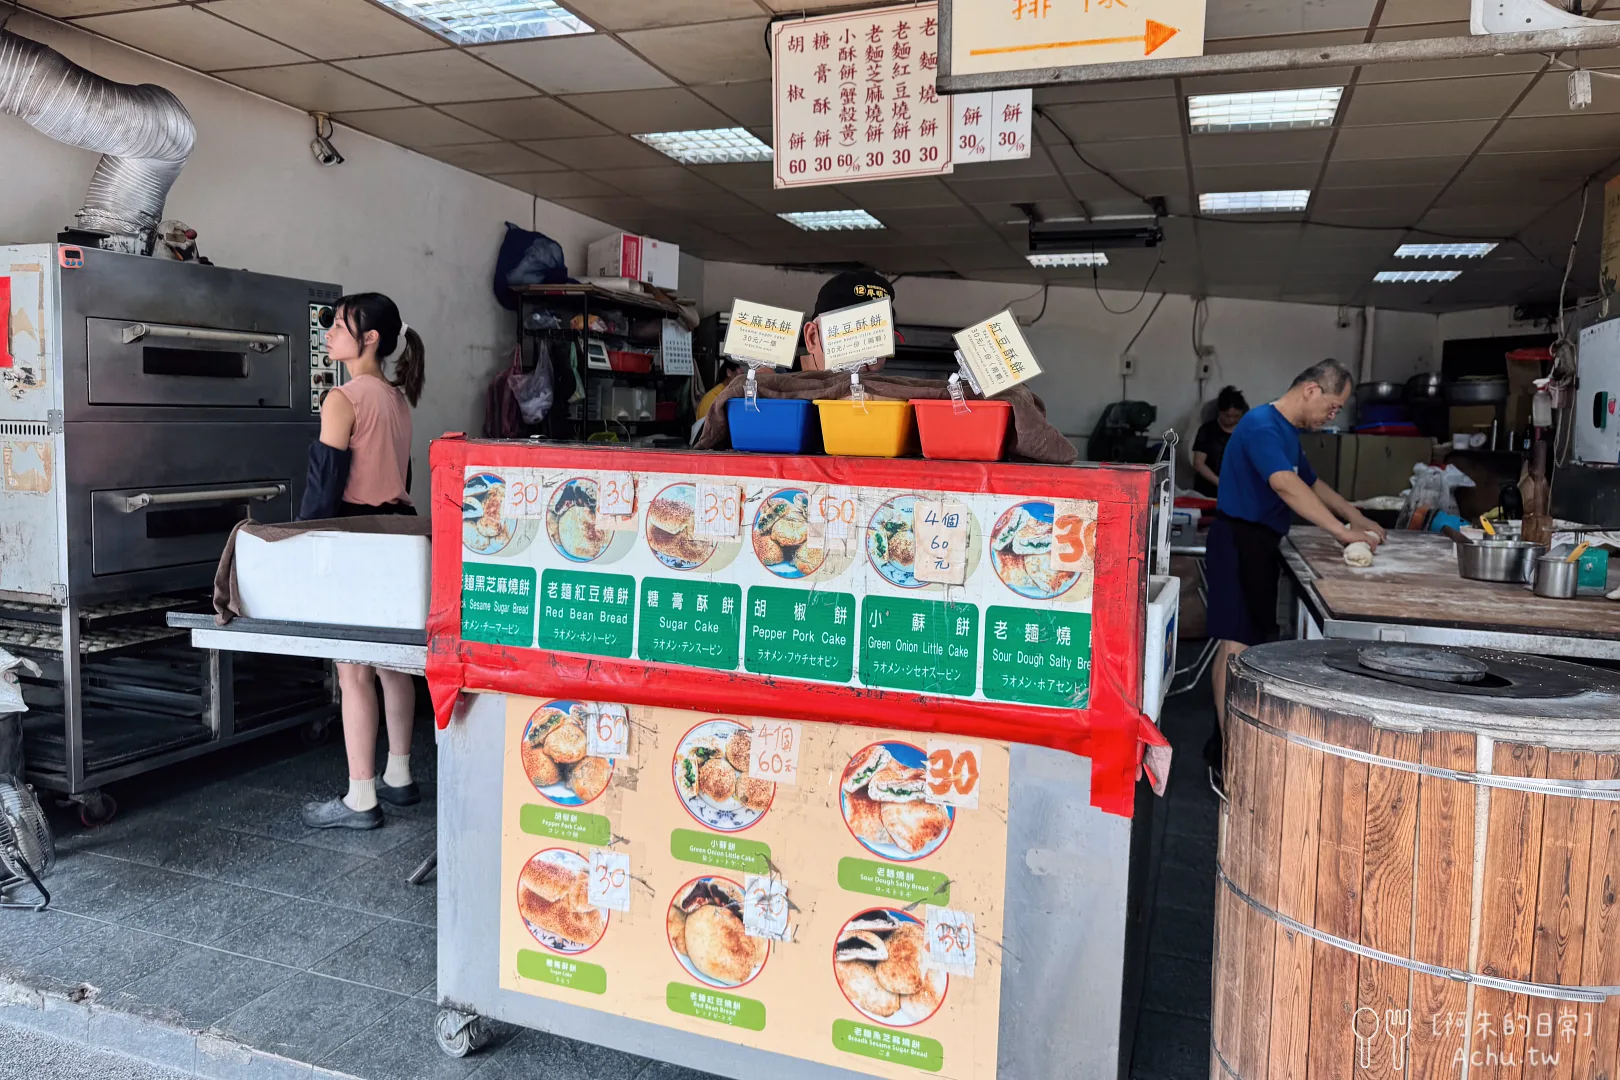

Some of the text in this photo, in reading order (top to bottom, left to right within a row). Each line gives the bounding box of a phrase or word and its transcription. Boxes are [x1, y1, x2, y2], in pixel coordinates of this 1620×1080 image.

[865, 24, 884, 143] 老麵芝麻燒餅
[891, 20, 911, 140] 老麵紅豆燒餅
[919, 17, 939, 138] 老麵燒餅
[787, 35, 806, 150] 胡椒餅
[812, 31, 832, 148] 糖膏酥餅
[962, 106, 982, 127] 餅
[1002, 103, 1023, 124] 餅
[815, 156, 832, 171] 30
[866, 151, 884, 167] 30
[892, 149, 911, 165] 30
[919, 146, 938, 162] 30
[789, 159, 806, 174] 60
[855, 286, 865, 295] 12
[737, 312, 791, 333] 芝麻酥餅
[828, 314, 882, 338] 綠豆酥餅
[989, 322, 1025, 374] 紅豆酥餅
[512, 481, 538, 506] 30
[705, 493, 737, 524] 30
[924, 510, 959, 528] 4個
[931, 535, 949, 550] 60
[934, 557, 950, 570] 元
[462, 573, 530, 596] 麵黑芝麻燒餅
[547, 581, 629, 605] 老麵紅豆燒餅
[470, 599, 491, 611] Sesame
[494, 601, 509, 615] Sugar
[513, 603, 529, 615] Bread
[647, 589, 734, 615] 糖膏酥餅
[754, 599, 847, 625] 胡椒餅
[545, 606, 628, 625] Red Bean Bread
[659, 616, 719, 633] Sugar Cake
[869, 609, 970, 637] 小蘇餅
[752, 625, 847, 646] Pepper Pork Cake
[994, 620, 1092, 648] 老麵燒
[868, 636, 969, 658] Green Onion Little Cake
[992, 648, 1012, 662] Sour
[1017, 651, 1044, 668] Dough
[1049, 654, 1072, 671] Salty
[597, 713, 625, 744] 60
[759, 751, 792, 773] 60元
[928, 748, 979, 795] 30
[689, 845, 755, 863] Green Onion Little Cake
[596, 865, 625, 895] 30
[860, 874, 929, 892] Sour Dough Salty Bread
[936, 922, 970, 952] 30
[869, 1039, 891, 1050] Sesame
[892, 1044, 910, 1055] Sugar
[910, 1048, 928, 1058] Bread
